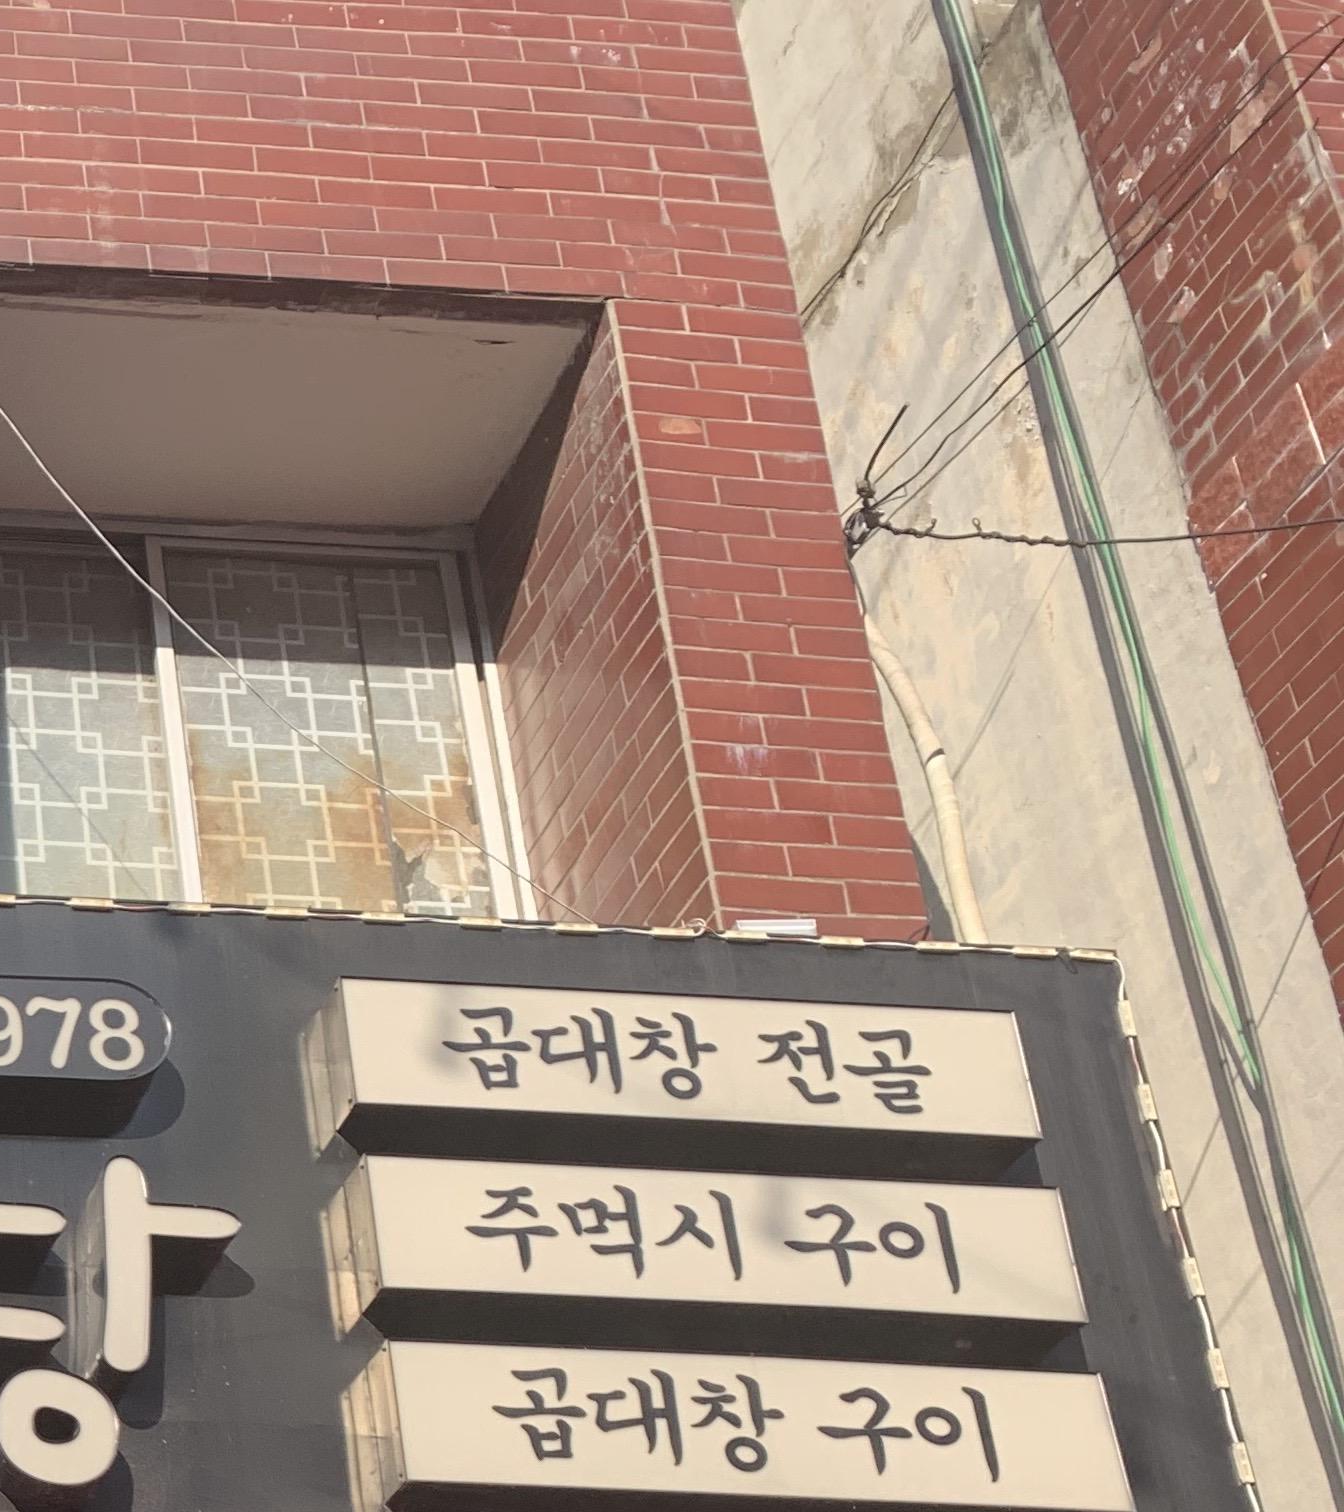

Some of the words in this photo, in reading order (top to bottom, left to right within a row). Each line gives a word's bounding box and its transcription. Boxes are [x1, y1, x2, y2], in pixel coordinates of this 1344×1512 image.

[442, 1006, 718, 1101] 곱대창
[757, 1020, 933, 1114] 전골
[466, 1185, 744, 1282] 주먹시
[784, 1202, 961, 1294] 구이
[493, 1366, 784, 1474] 곱대창
[817, 1386, 1001, 1484] 구이
